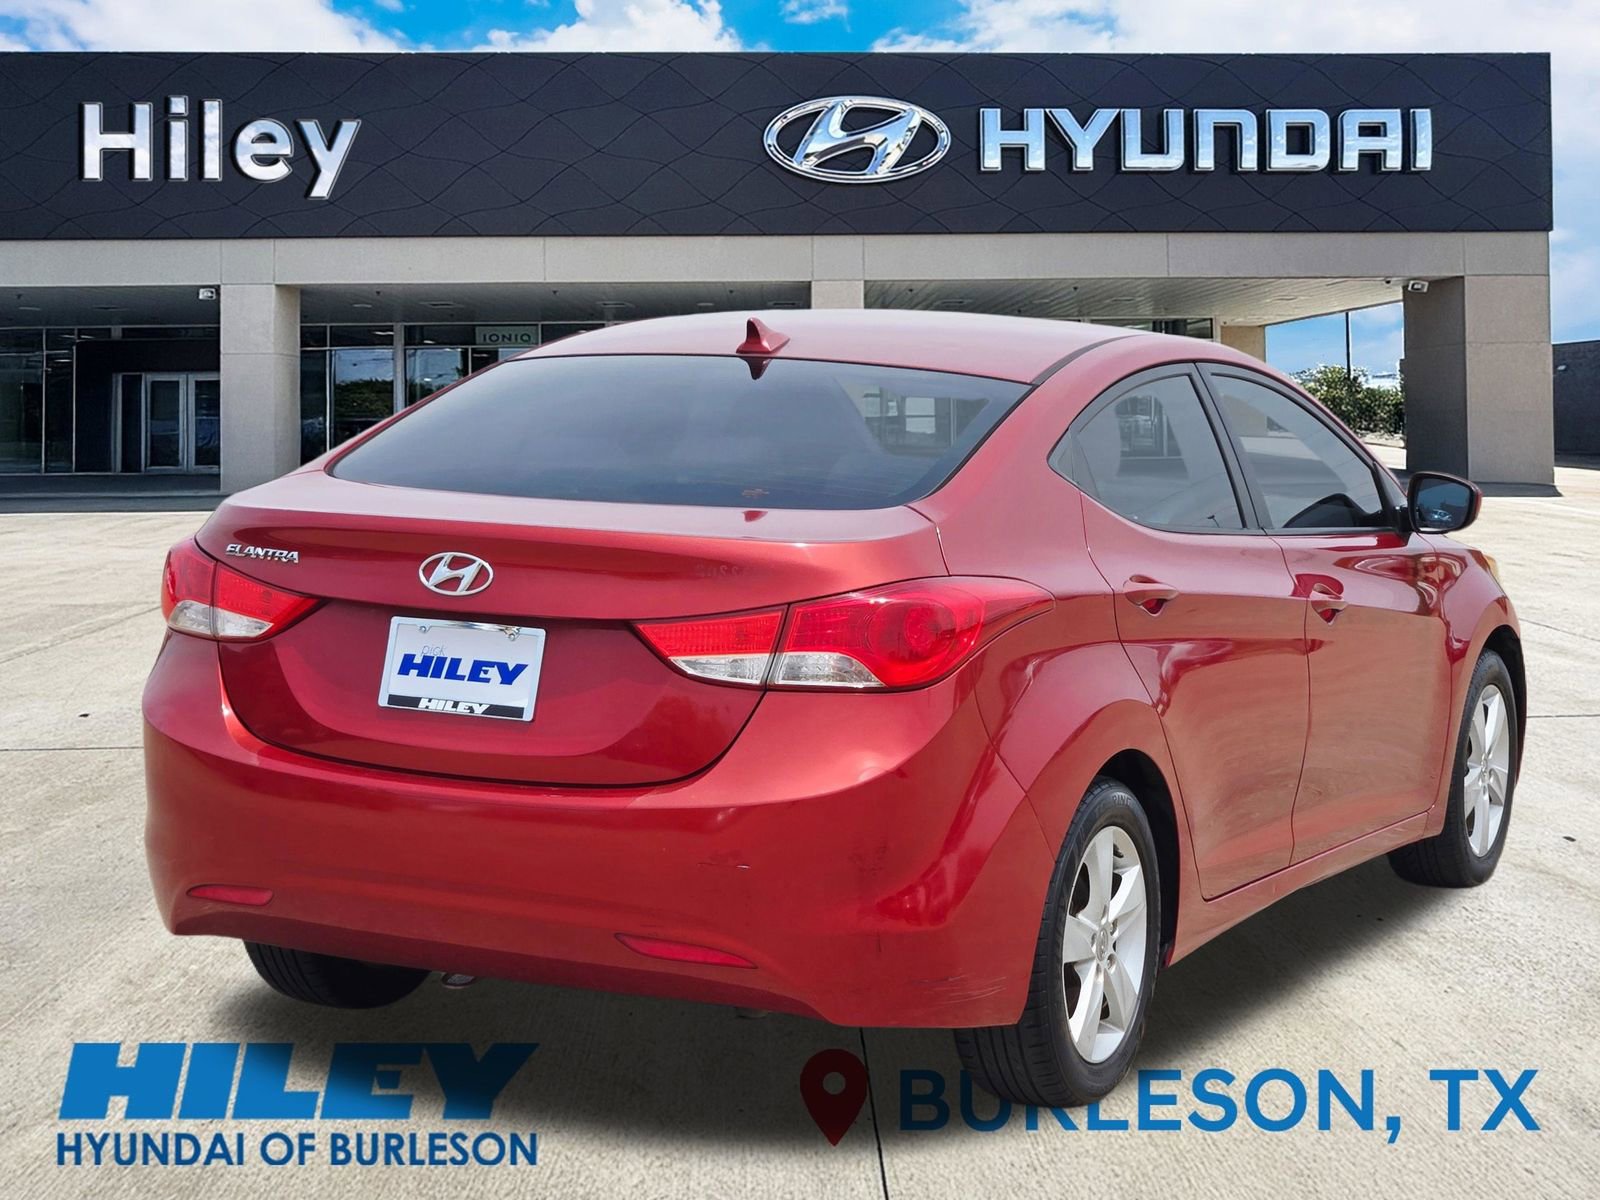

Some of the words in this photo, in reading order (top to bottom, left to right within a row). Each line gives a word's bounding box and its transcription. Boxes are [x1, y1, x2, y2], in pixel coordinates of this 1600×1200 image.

[81, 95, 362, 200] Hiley
[979, 107, 1433, 172] HYUNDAI
[482, 333, 532, 343] IONIQ
[225, 543, 299, 564] ELANTRA
[397, 653, 528, 685] HILEY
[417, 697, 491, 715] HILEY
